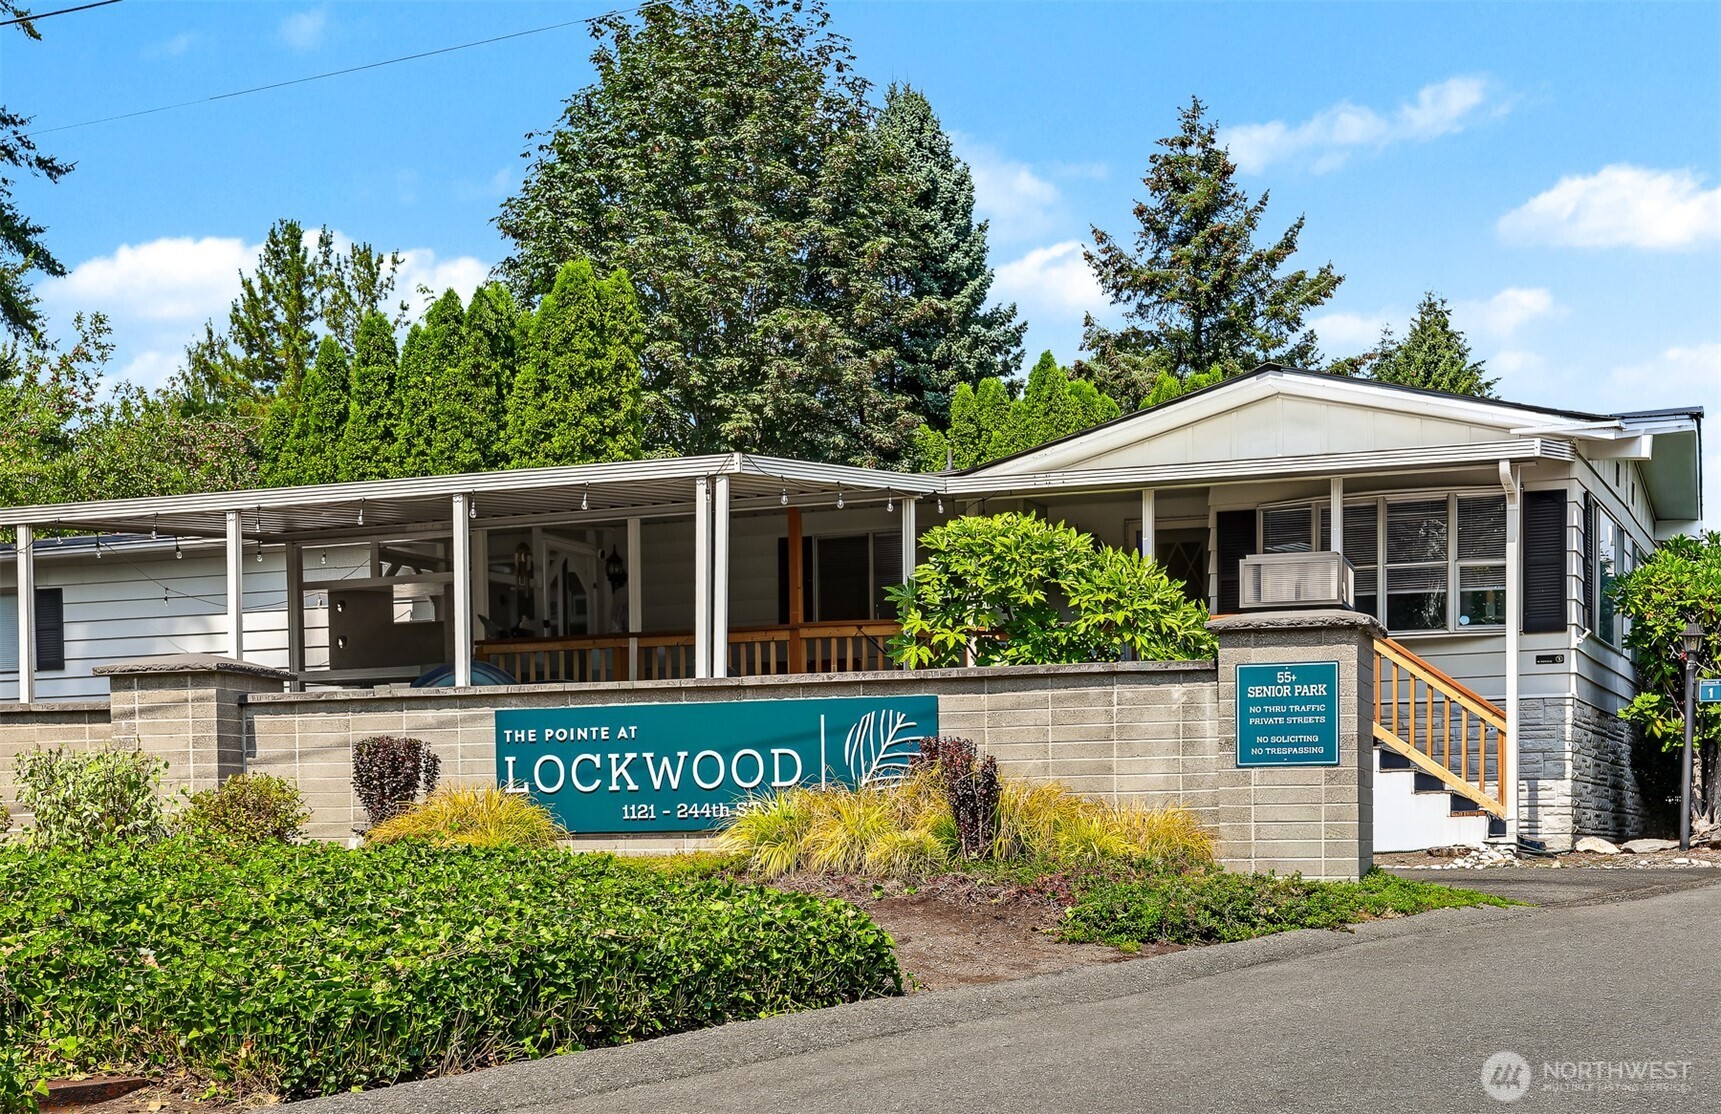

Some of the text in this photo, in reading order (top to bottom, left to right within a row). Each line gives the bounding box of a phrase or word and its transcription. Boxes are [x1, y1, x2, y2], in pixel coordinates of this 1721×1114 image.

[1277, 672, 1296, 683] 55+
[1248, 684, 1327, 698] SENIOR PARK
[1289, 704, 1325, 712] TRAFFIC
[504, 726, 637, 743] THE POINTE AT
[505, 748, 802, 794] LOCKWOOD
[622, 804, 655, 820] 1121
[677, 803, 730, 819] 244th
